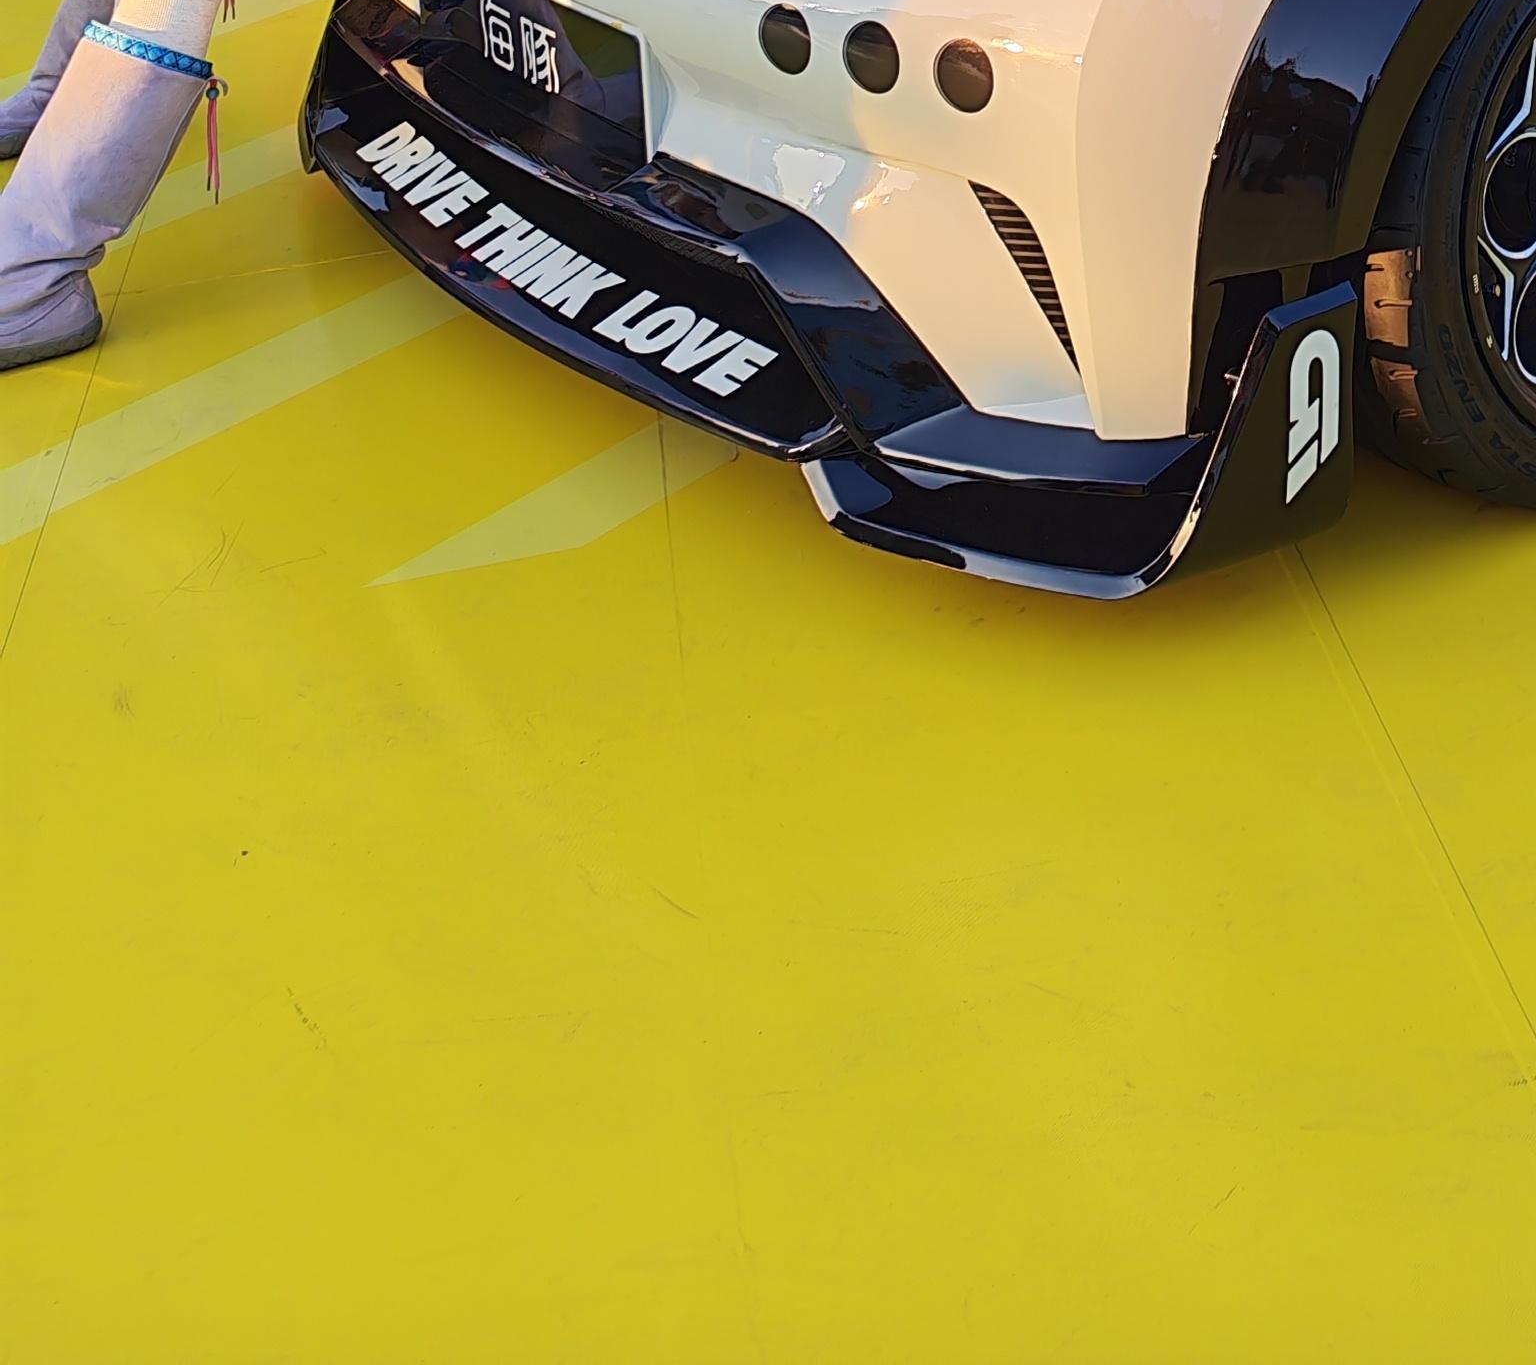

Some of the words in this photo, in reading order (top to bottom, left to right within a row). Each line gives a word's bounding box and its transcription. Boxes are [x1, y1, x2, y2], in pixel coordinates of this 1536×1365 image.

[355, 120, 491, 229] DRIVE
[453, 201, 627, 321] THINK
[591, 290, 780, 398] LOVE
